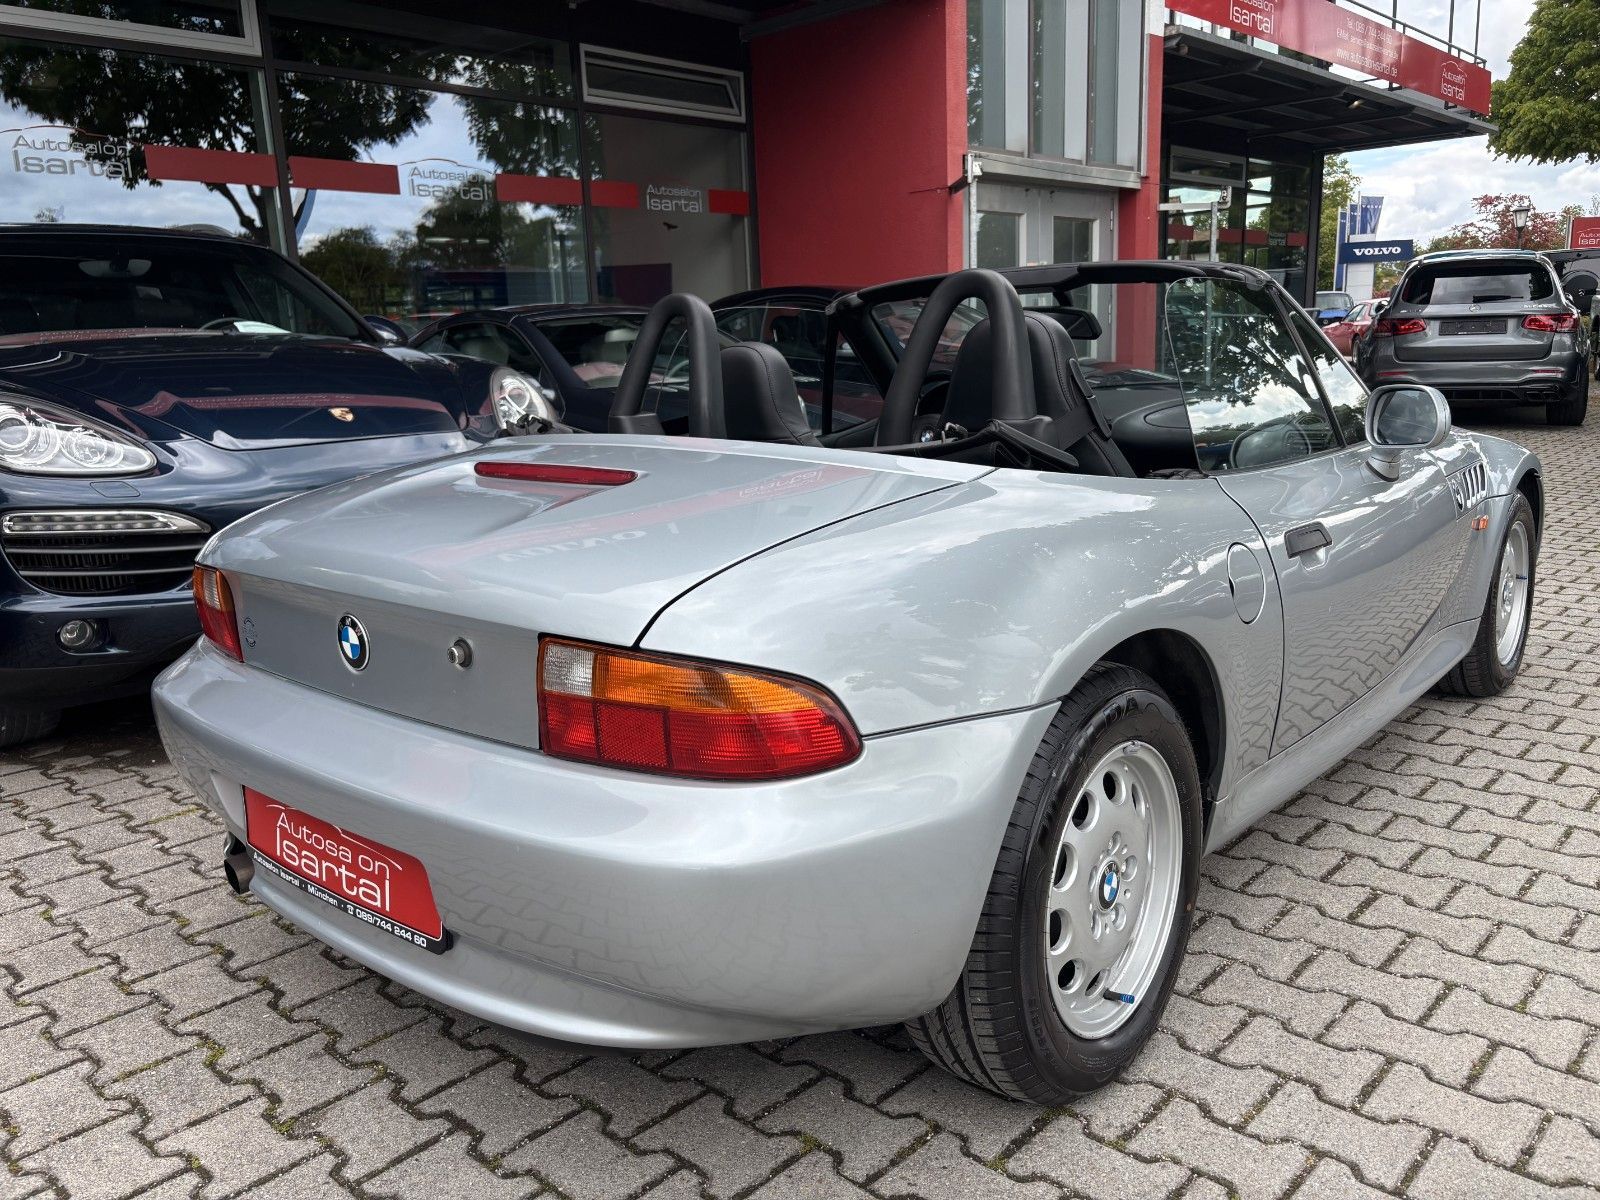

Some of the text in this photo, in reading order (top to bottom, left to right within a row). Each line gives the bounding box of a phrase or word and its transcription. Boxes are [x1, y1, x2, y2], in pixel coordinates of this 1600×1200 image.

[1230, 0, 1274, 35] Isartal
[1442, 68, 1466, 85] Autosalon
[1441, 78, 1466, 101] Isartal
[12, 134, 130, 157] Autosalon
[12, 149, 133, 179] Isartal
[408, 178, 489, 201] Isartal
[647, 184, 701, 198] Autosalon
[646, 194, 703, 213] Isartal
[1352, 246, 1402, 257] VOLVO
[276, 811, 390, 880] Autosaon
[275, 827, 391, 912] Isartal
[253, 851, 428, 948] Autosalon Isartal München 089/744 244 60
